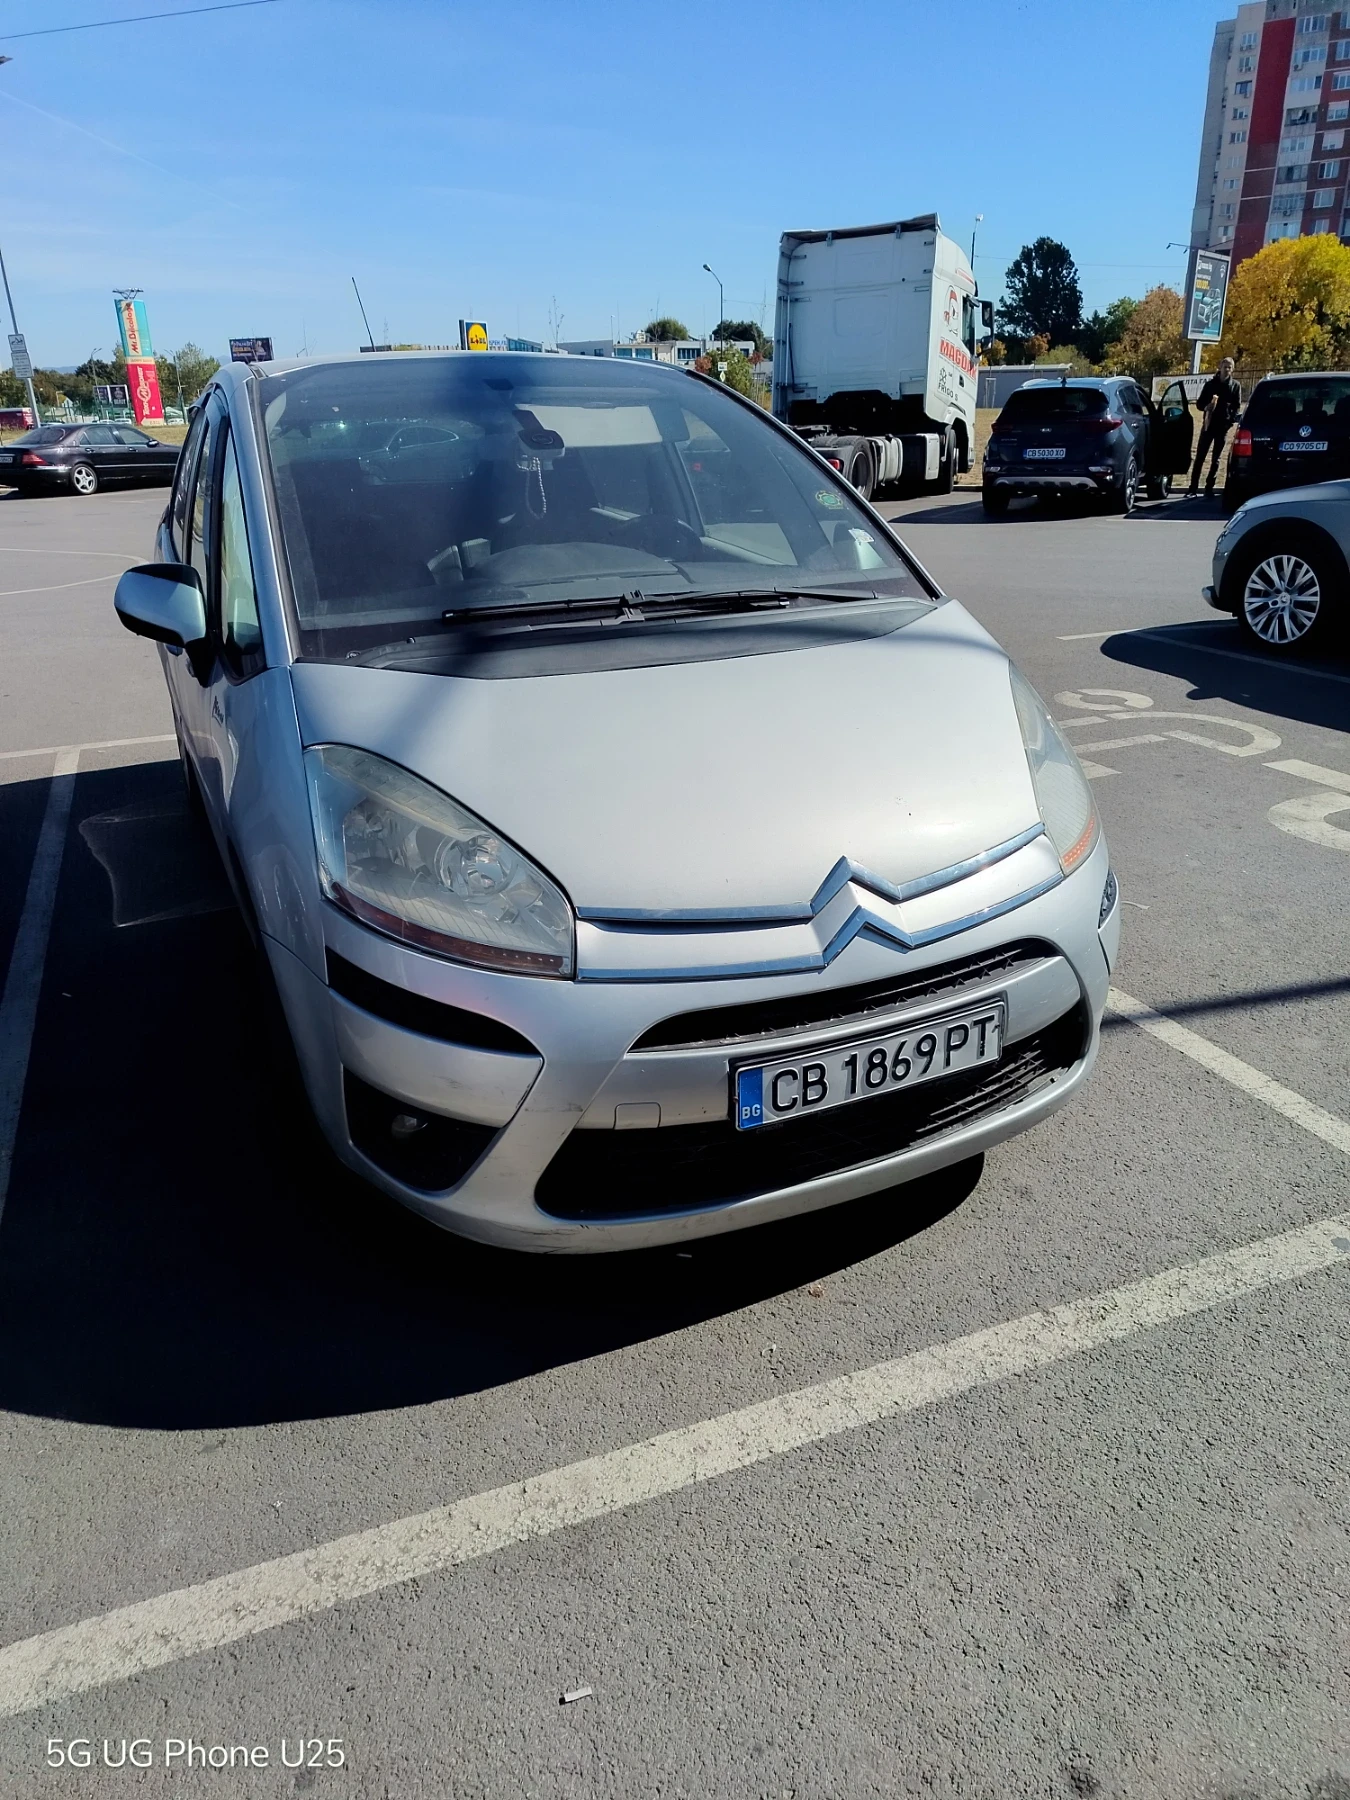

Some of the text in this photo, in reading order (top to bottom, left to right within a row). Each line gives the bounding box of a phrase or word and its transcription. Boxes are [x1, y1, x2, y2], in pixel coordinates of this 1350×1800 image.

[1296, 442, 1315, 450] 9705
[1027, 449, 1037, 457] CB
[1038, 449, 1054, 457] 5030
[771, 1013, 996, 1113] CB 1869 PT
[741, 1103, 762, 1120] BG
